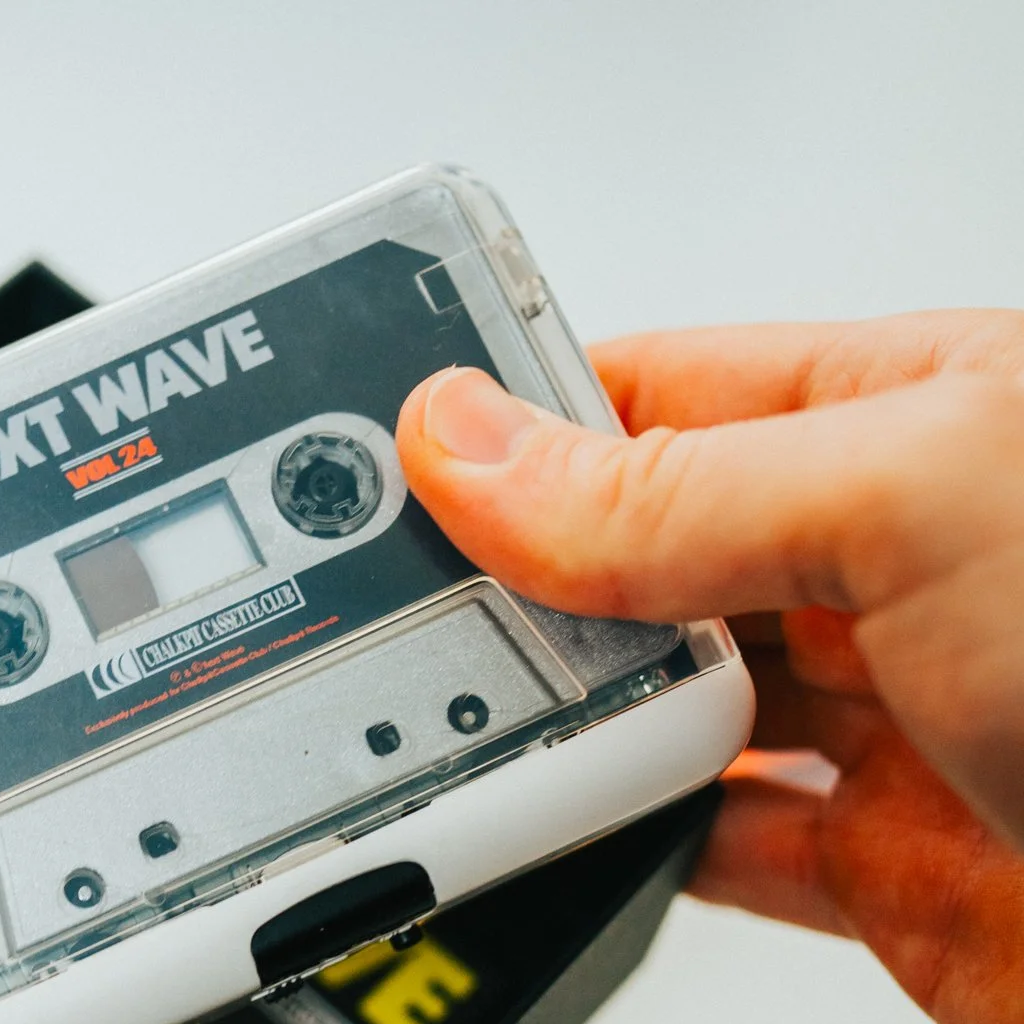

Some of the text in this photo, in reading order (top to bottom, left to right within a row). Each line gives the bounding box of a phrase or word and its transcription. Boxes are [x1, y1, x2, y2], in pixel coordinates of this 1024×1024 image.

[72, 310, 275, 436] WAVE
[65, 436, 158, 489] VOL 24
[201, 598, 264, 640] CASSETTE
[260, 583, 296, 615] CLUB
